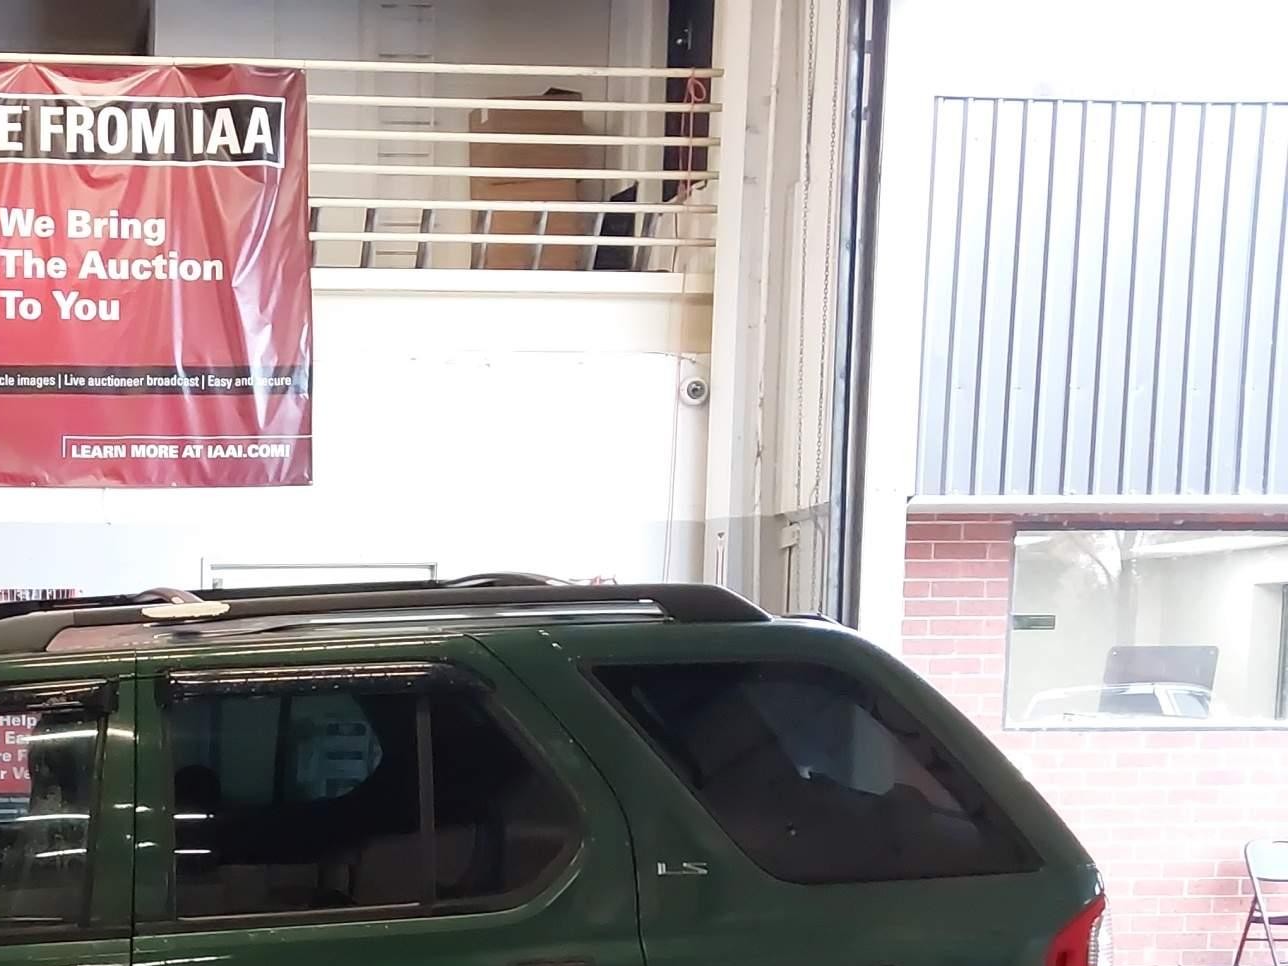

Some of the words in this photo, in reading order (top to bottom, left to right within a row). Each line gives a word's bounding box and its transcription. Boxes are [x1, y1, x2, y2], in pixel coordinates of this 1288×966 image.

[41, 106, 177, 154] FROM
[192, 106, 274, 155] IAA
[67, 210, 166, 247] Bring
[79, 251, 224, 282] Auction
[53, 290, 121, 322] You
[17, 374, 56, 388] images
[64, 374, 86, 386] Live
[88, 374, 143, 387] auctioneer
[147, 374, 199, 386] broadcast
[208, 375, 232, 389] Easy
[235, 376, 255, 387] and
[257, 376, 292, 387] ecure
[72, 444, 126, 459] LEARN
[131, 445, 179, 459] MORE
[182, 445, 204, 459] AT
[0, 715, 37, 729] Help
[12, 767, 31, 780] Ve
